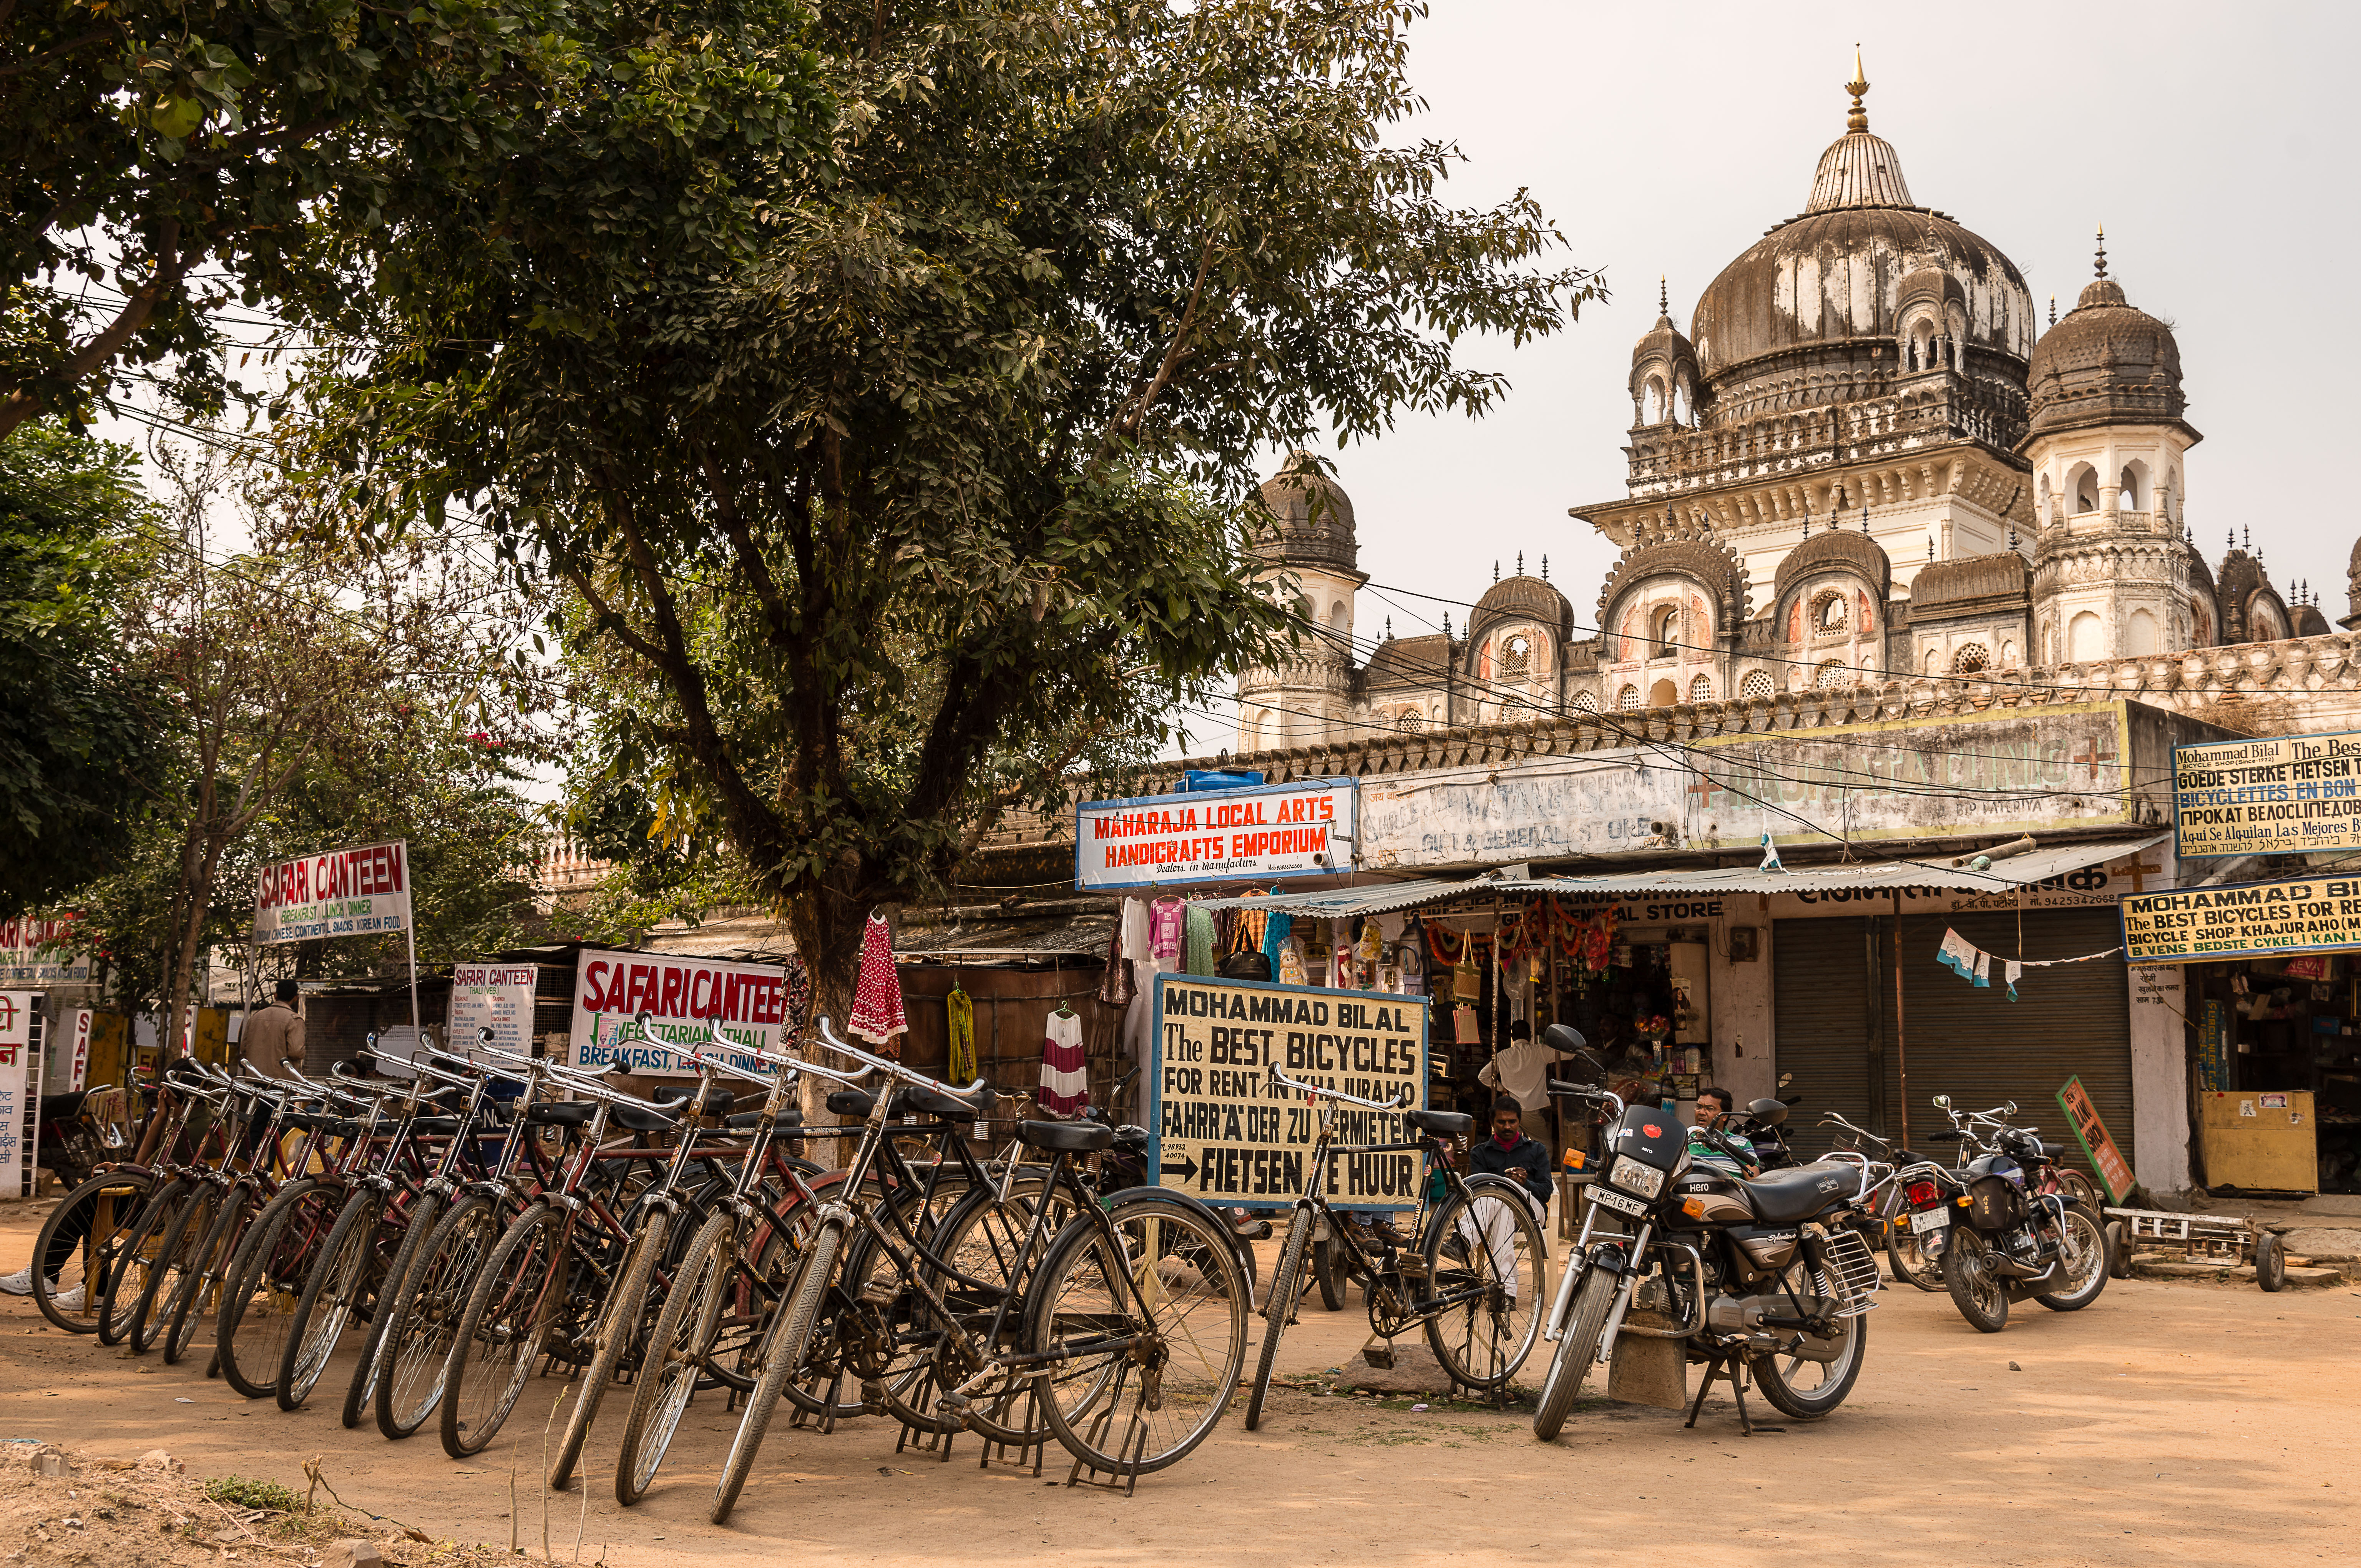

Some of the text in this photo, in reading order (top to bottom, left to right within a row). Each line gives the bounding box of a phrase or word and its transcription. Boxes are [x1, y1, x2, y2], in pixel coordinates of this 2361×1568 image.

[2177, 743, 2279, 764] Mohammad Bilal
[2292, 739, 2361, 760] The Bes
[2178, 770, 2225, 789] GOEDE
[2230, 767, 2286, 785] STERKE
[2293, 759, 2351, 780] FIETSEN
[2180, 779, 2356, 808] BICYCLETTES EN BON
[1095, 796, 1333, 840] MAHARAJA LOCAL ARTS
[2180, 807, 2242, 826] ПРОКАТ
[1105, 827, 1326, 868] HANDICRAFTS EMPORIUM
[2180, 828, 2207, 845] Aquí
[2210, 827, 2222, 840] Se
[2225, 825, 2272, 842] Alquilan
[2276, 823, 2298, 837] Las
[2302, 821, 2347, 837] Mejores
[259, 845, 403, 910] SAFARI CANTEEN
[1156, 863, 1186, 874] Dealers
[1189, 862, 1199, 871] in
[1202, 859, 1257, 873] Manufacturs
[349, 899, 372, 916] DINNER
[1646, 901, 1724, 920] STORE
[2131, 880, 2361, 913] MOHAMMAD BI
[357, 918, 381, 931] KOREAN
[384, 915, 400, 929] FOOD
[2125, 916, 2150, 931] The
[2153, 912, 2197, 929] BEST
[2204, 905, 2291, 925] BICYCLES
[2297, 901, 2334, 918] FOR
[2127, 930, 2189, 945] BICYCLE
[2196, 927, 2235, 940] SHOP
[2240, 919, 2339, 937] KHAJURAHO
[2147, 944, 2187, 955] VENS
[2193, 939, 2248, 952] BEDSTE
[2254, 936, 2297, 947] CYKEL
[2311, 932, 2346, 943] KAN
[2352, 932, 2361, 941] L
[455, 969, 534, 986] SAFARI CANTEEN
[469, 986, 499, 996] THALI (VEG.)
[1165, 988, 1410, 1033] MOHAMMAD BILAL
[722, 1028, 766, 1049] THALI
[1164, 1023, 1415, 1075] The BEST BICYCLES
[1165, 1067, 1202, 1095] FOR
[1210, 1070, 1260, 1099] RENT
[1287, 1108, 1311, 1143] ZU
[1199, 1148, 1303, 1194] FIETSEN
[1348, 1152, 1414, 1197] HUUR
[910, 1198, 927, 1238] HER
[1409, 1198, 1424, 1239] HERO
